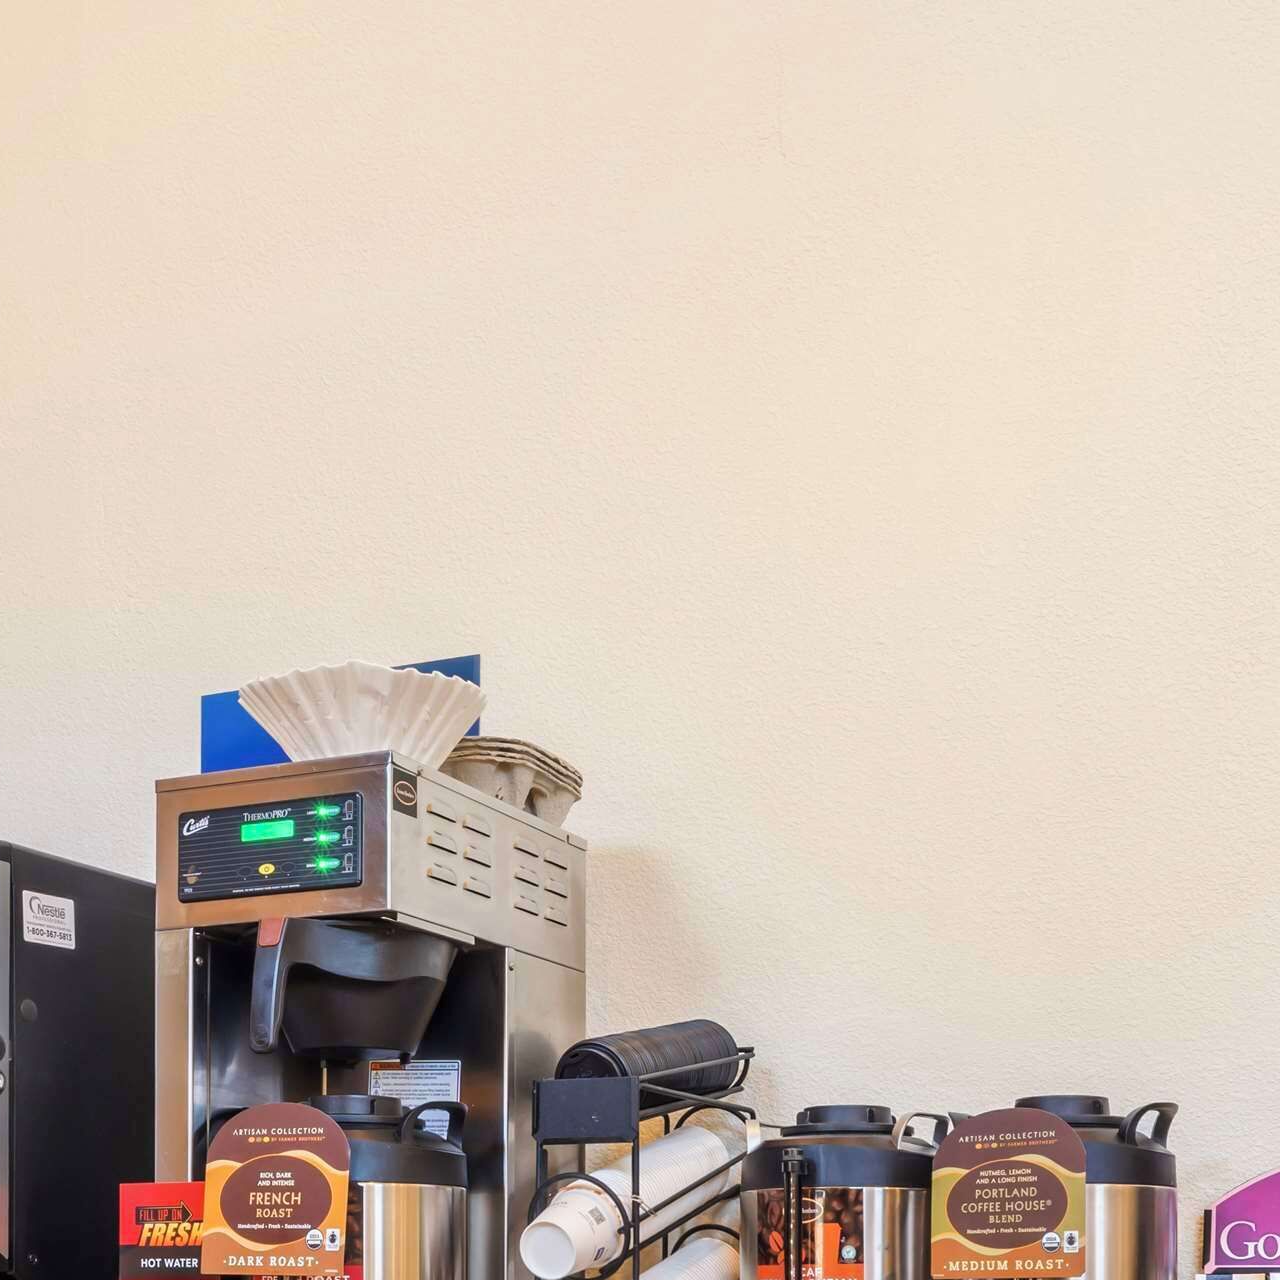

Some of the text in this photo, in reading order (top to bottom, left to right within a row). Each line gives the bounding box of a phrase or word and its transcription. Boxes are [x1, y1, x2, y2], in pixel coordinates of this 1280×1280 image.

[183, 816, 210, 836] Curtis
[233, 1127, 324, 1136] ARTISAN COLLECTION
[959, 1130, 1056, 1143] ARTISAN COLLECTION
[1009, 1168, 1032, 1176] LEMON
[249, 1192, 302, 1205] FRENCH
[975, 1187, 1038, 1199] PORTLAND
[256, 1208, 293, 1218] ROAST
[961, 1202, 1001, 1214] COFFEE
[989, 1214, 1023, 1224] BLEND
[138, 1222, 203, 1247] FRESH
[141, 1258, 199, 1268] HOT WATER
[228, 1255, 315, 1267] DARK ROAST
[949, 1259, 1064, 1271] MEDIUM ROAST
